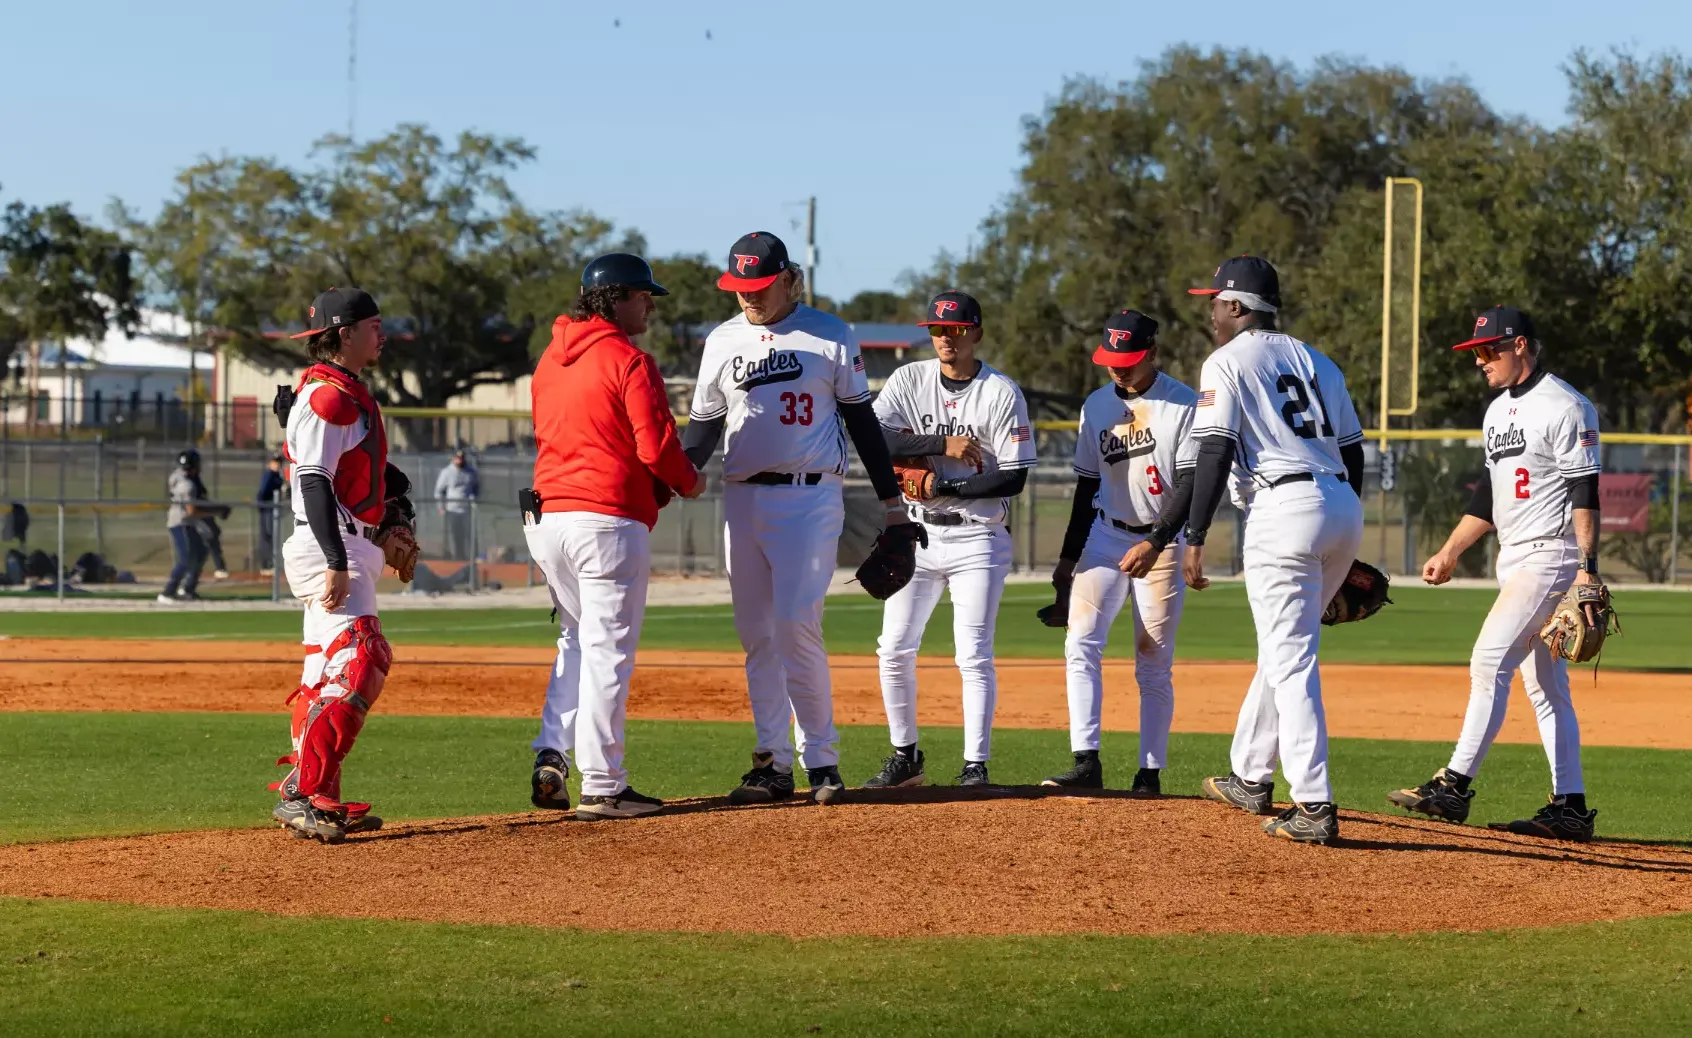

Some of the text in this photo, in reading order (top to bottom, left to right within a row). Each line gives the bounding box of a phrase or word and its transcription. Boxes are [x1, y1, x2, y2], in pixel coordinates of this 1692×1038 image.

[733, 253, 760, 275] P
[934, 300, 959, 319] P
[1107, 328, 1132, 349] P
[733, 348, 801, 383] Eagles
[779, 391, 813, 426] 33
[1276, 373, 1335, 440] 21
[1099, 424, 1155, 455] Eagles
[1487, 422, 1526, 457] Eagles
[1146, 465, 1164, 496] 3
[1515, 467, 1530, 499] 2
